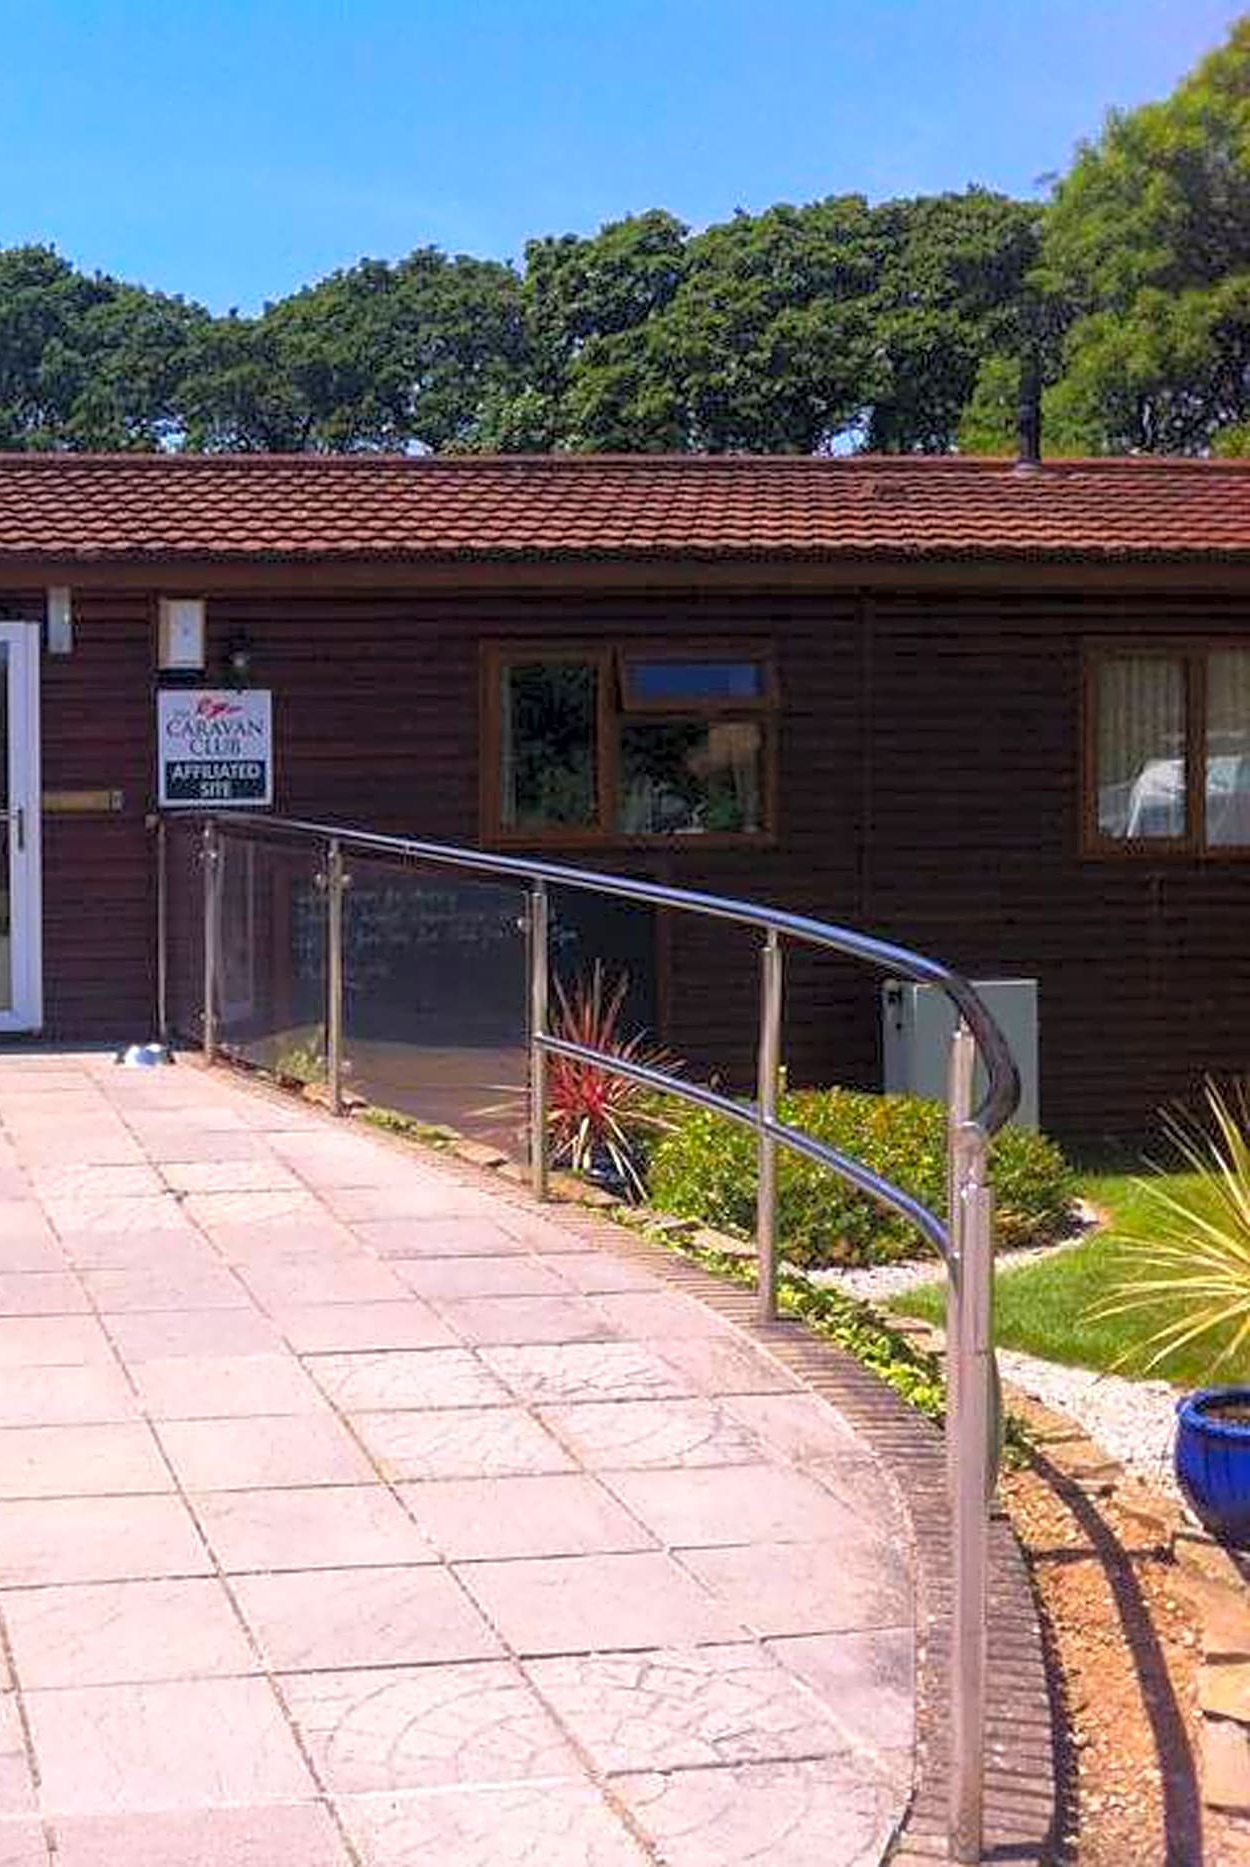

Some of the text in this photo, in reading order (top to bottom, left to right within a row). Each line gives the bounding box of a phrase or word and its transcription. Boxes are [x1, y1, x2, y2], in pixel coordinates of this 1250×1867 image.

[166, 718, 263, 738] CARAVAN
[190, 737, 241, 754] CLUB
[172, 763, 261, 780] AFFILIATED
[200, 781, 229, 798] SITE
